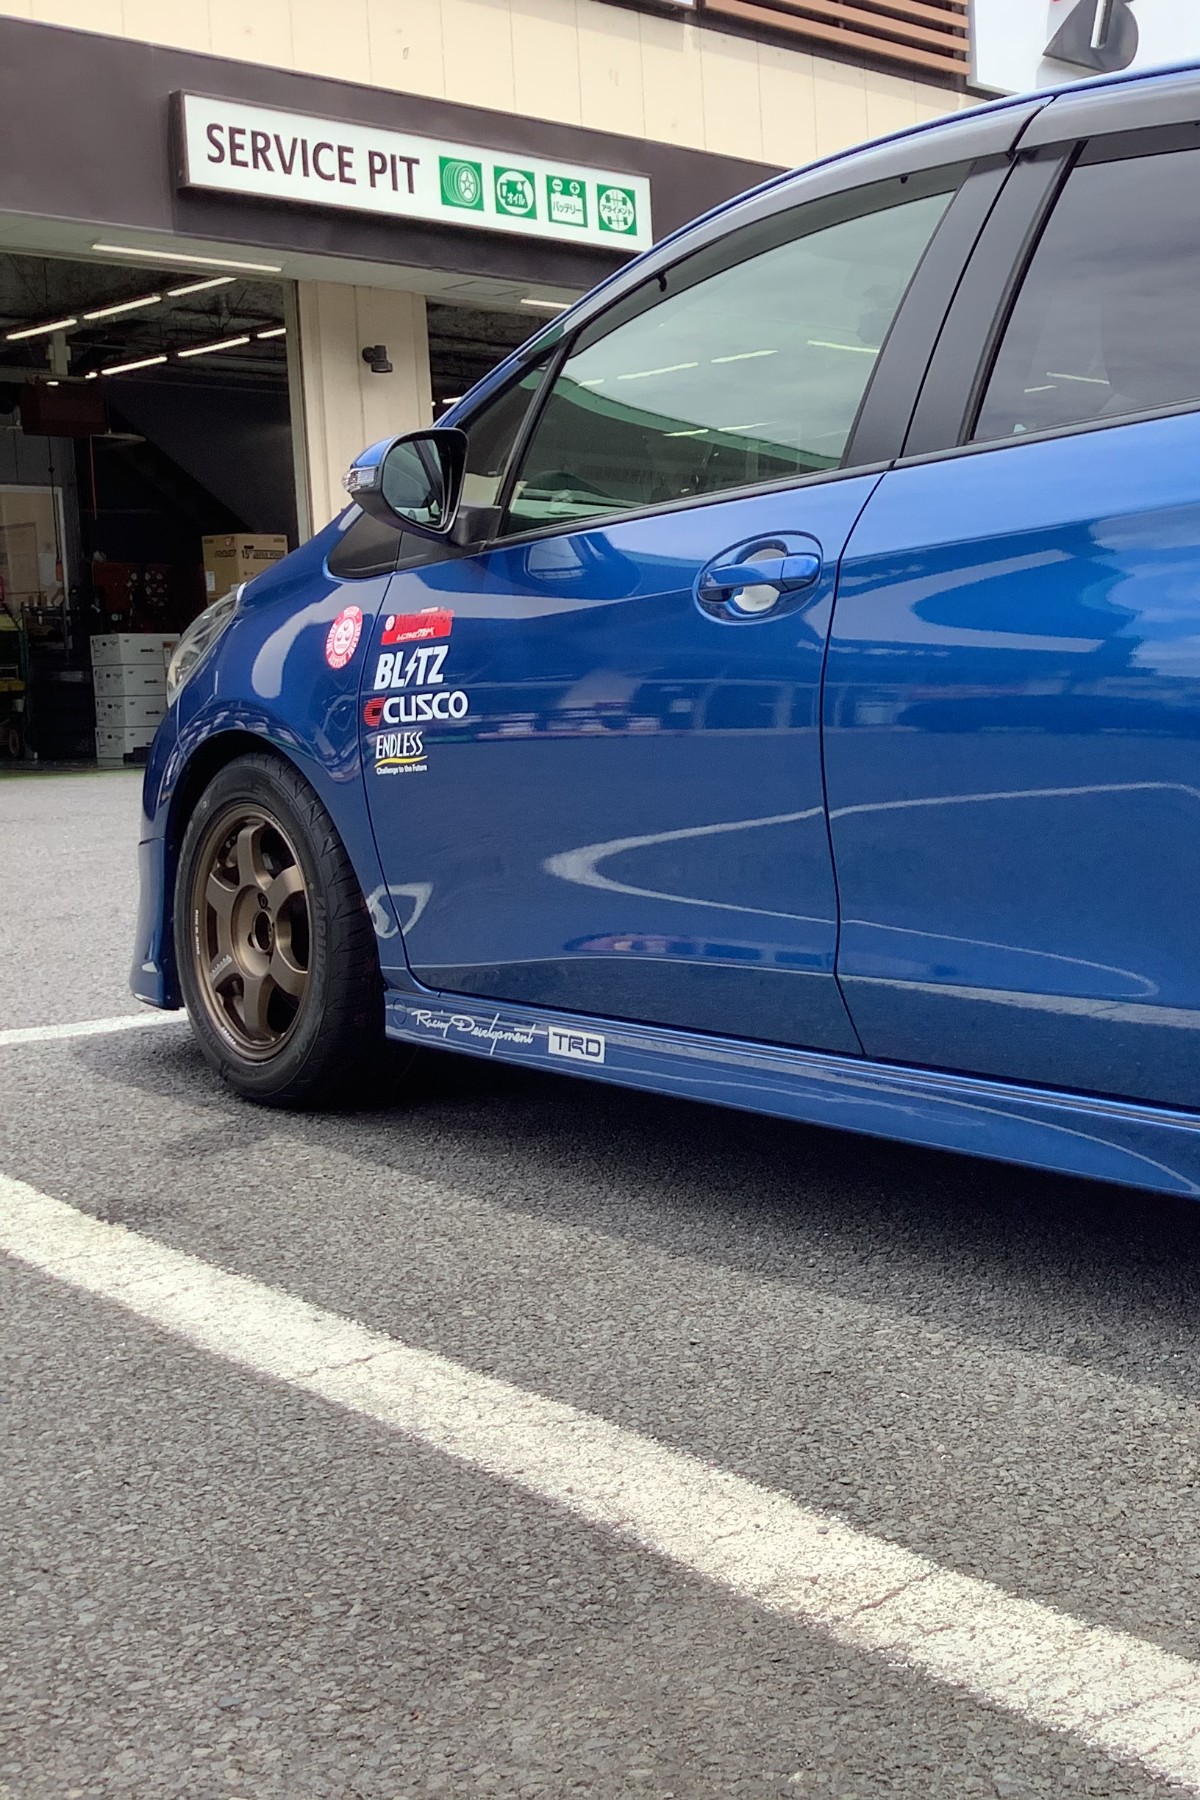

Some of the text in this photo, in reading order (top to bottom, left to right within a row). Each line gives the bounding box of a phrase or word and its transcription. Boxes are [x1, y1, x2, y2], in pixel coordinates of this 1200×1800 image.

[206, 122, 420, 194] SERVICE PIT
[507, 191, 526, 206] オイル
[552, 201, 583, 215] バッテリー
[601, 203, 633, 217] アライメント
[373, 645, 449, 690] BLITZ
[382, 690, 468, 724] CUSCO
[375, 731, 423, 759] ENDLESS
[551, 1030, 602, 1059] TRD
